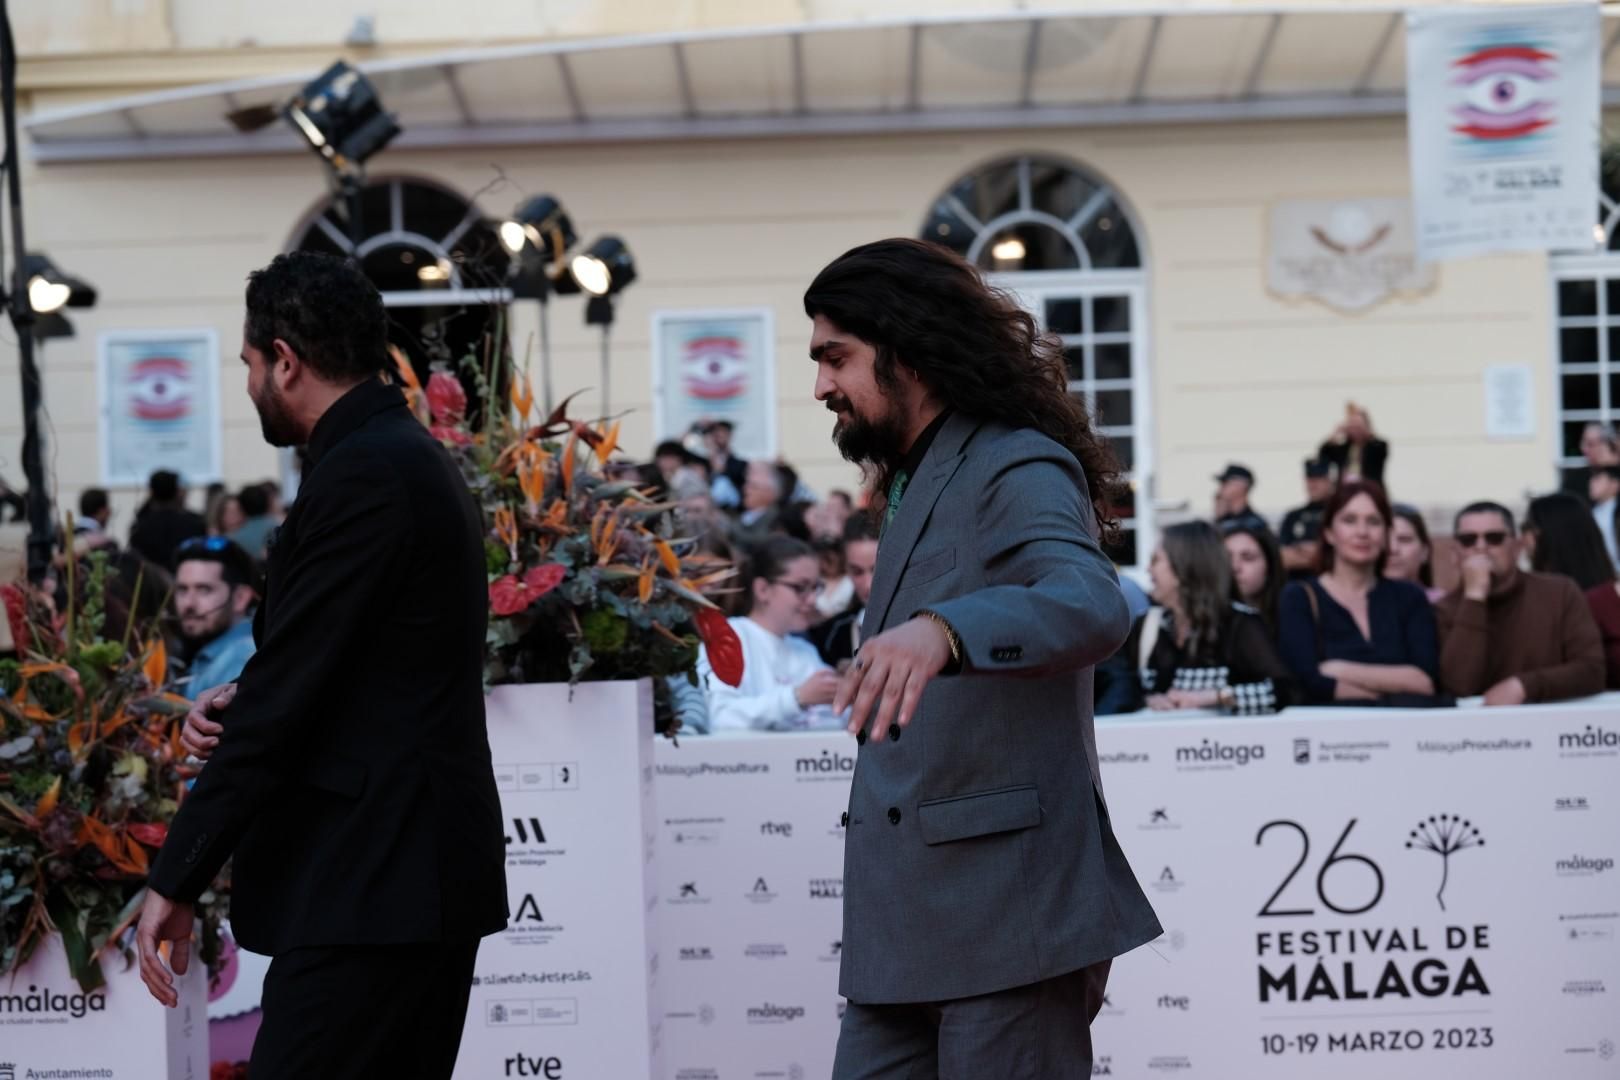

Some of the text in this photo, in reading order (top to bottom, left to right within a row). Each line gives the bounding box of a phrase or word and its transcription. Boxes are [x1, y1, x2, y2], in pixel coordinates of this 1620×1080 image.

[1559, 724, 1620, 748] mála
[796, 749, 854, 772] mála
[760, 821, 793, 838] rtve
[1255, 819, 1385, 917] 26
[1256, 925, 1490, 956] FESTIVAL DE
[1258, 955, 1491, 1003] MÁLAGA
[1157, 994, 1190, 1011] rtve
[1261, 1027, 1494, 1055] 10-19 MARZO 2023
[26, 1067, 113, 1080] Ayuntamiento
[504, 1052, 562, 1080] rtve
